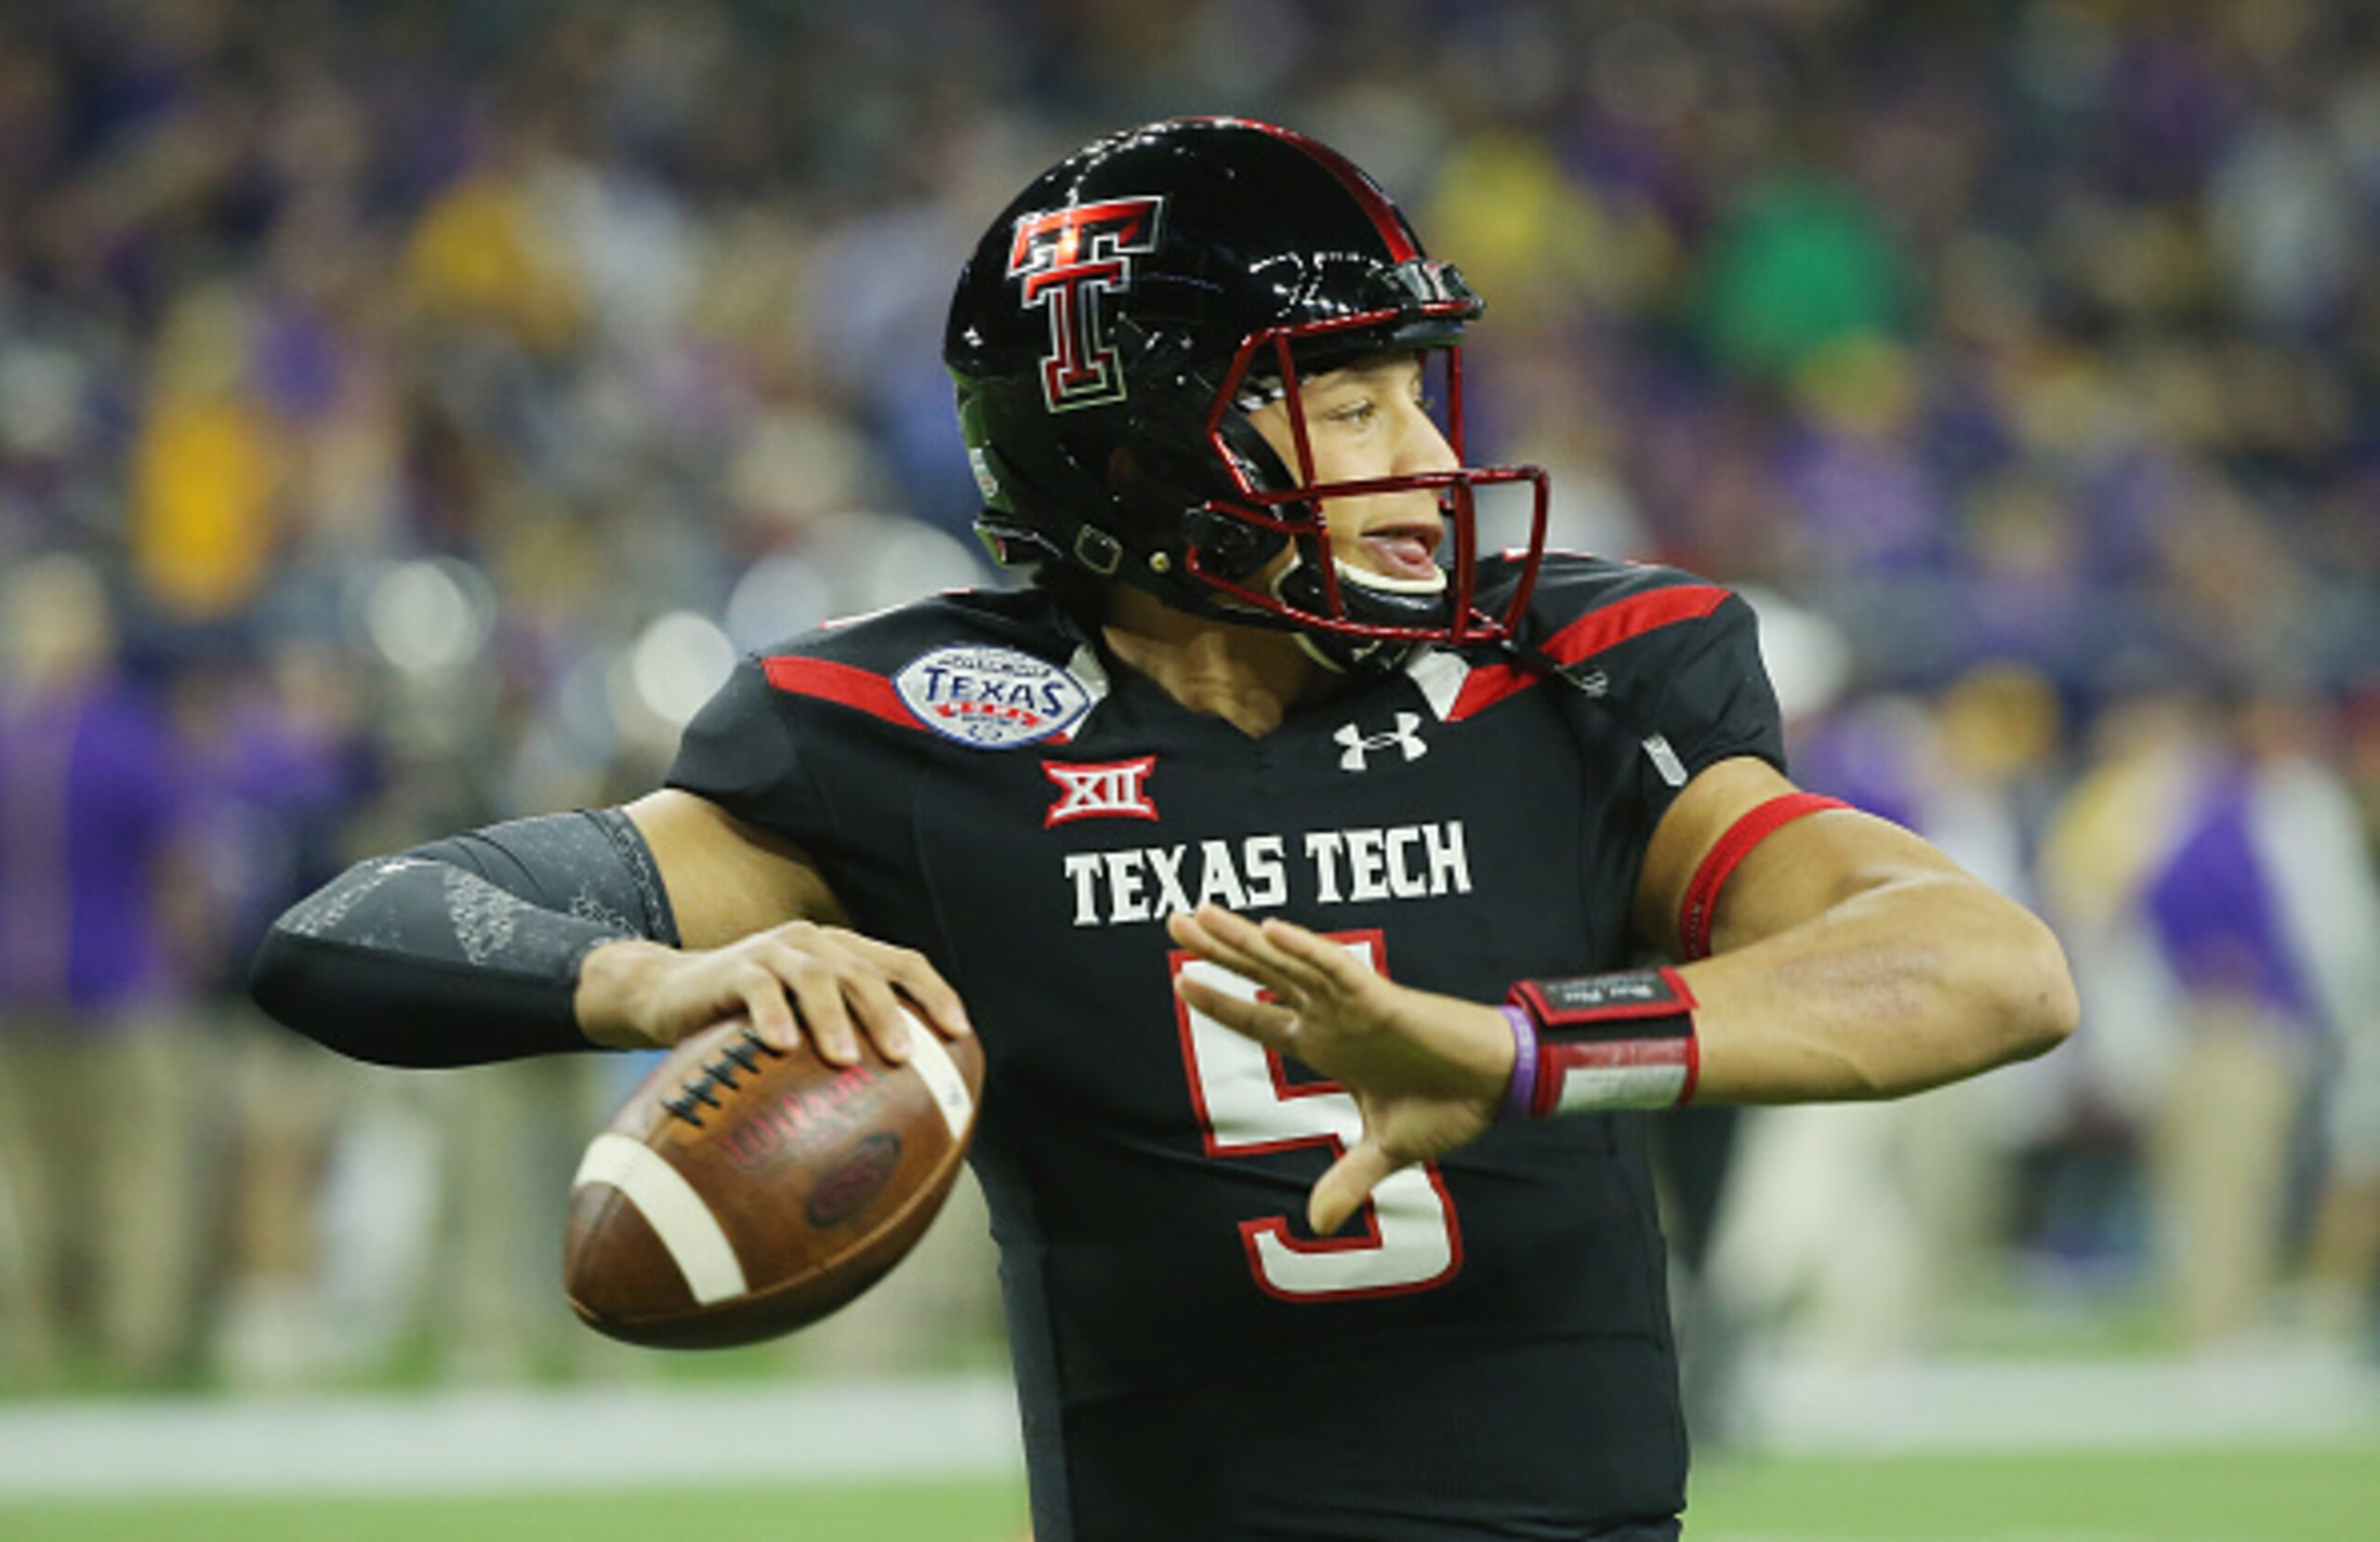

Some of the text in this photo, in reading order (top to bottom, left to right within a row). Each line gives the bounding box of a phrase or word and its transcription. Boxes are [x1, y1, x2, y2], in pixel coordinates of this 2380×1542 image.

[923, 666, 1065, 718] TEXAS
[1064, 820, 1473, 927] TEXAS TECH
[1168, 929, 1463, 1302] 5
